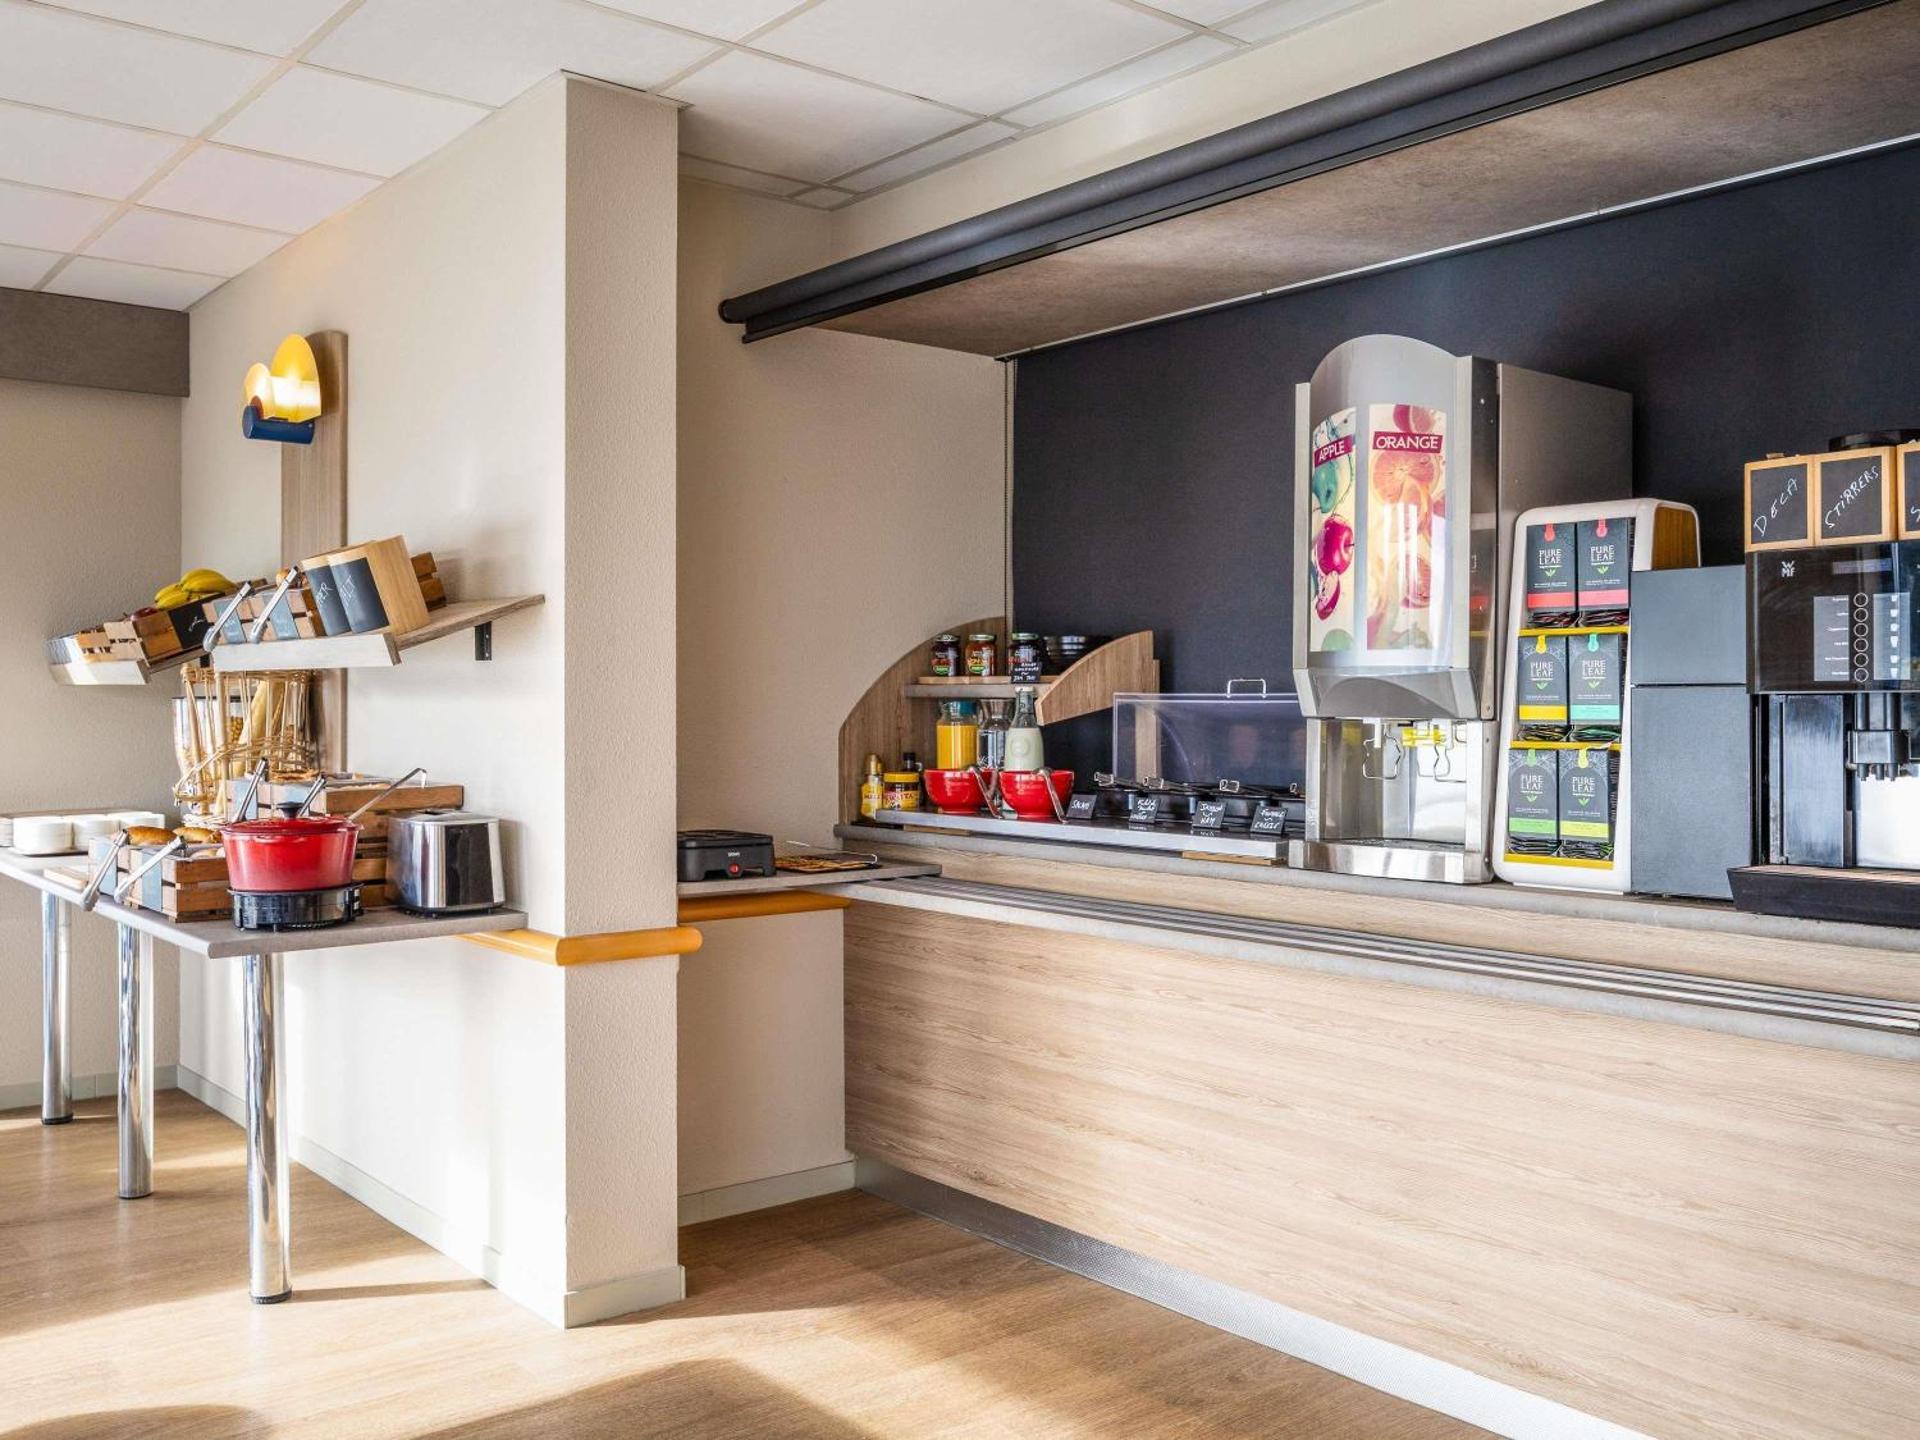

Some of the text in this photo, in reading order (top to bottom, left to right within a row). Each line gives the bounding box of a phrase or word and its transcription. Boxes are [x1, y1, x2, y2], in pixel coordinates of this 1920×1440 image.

[1376, 435, 1438, 449] ORANGE
[1319, 440, 1345, 462] APPLE
[1539, 548, 1562, 558] PURE
[1591, 545, 1614, 555] PURE
[1539, 556, 1562, 565] LEAF
[1591, 552, 1614, 562] LEAF
[1530, 661, 1554, 670] PURE
[1582, 659, 1607, 668] PURE
[1530, 669, 1554, 678] LEAF
[1582, 667, 1606, 676] LEAF
[1520, 774, 1543, 783] PURE
[1572, 776, 1595, 785] PURE
[1521, 782, 1543, 790] LEAF
[1572, 784, 1595, 793] LEAF
